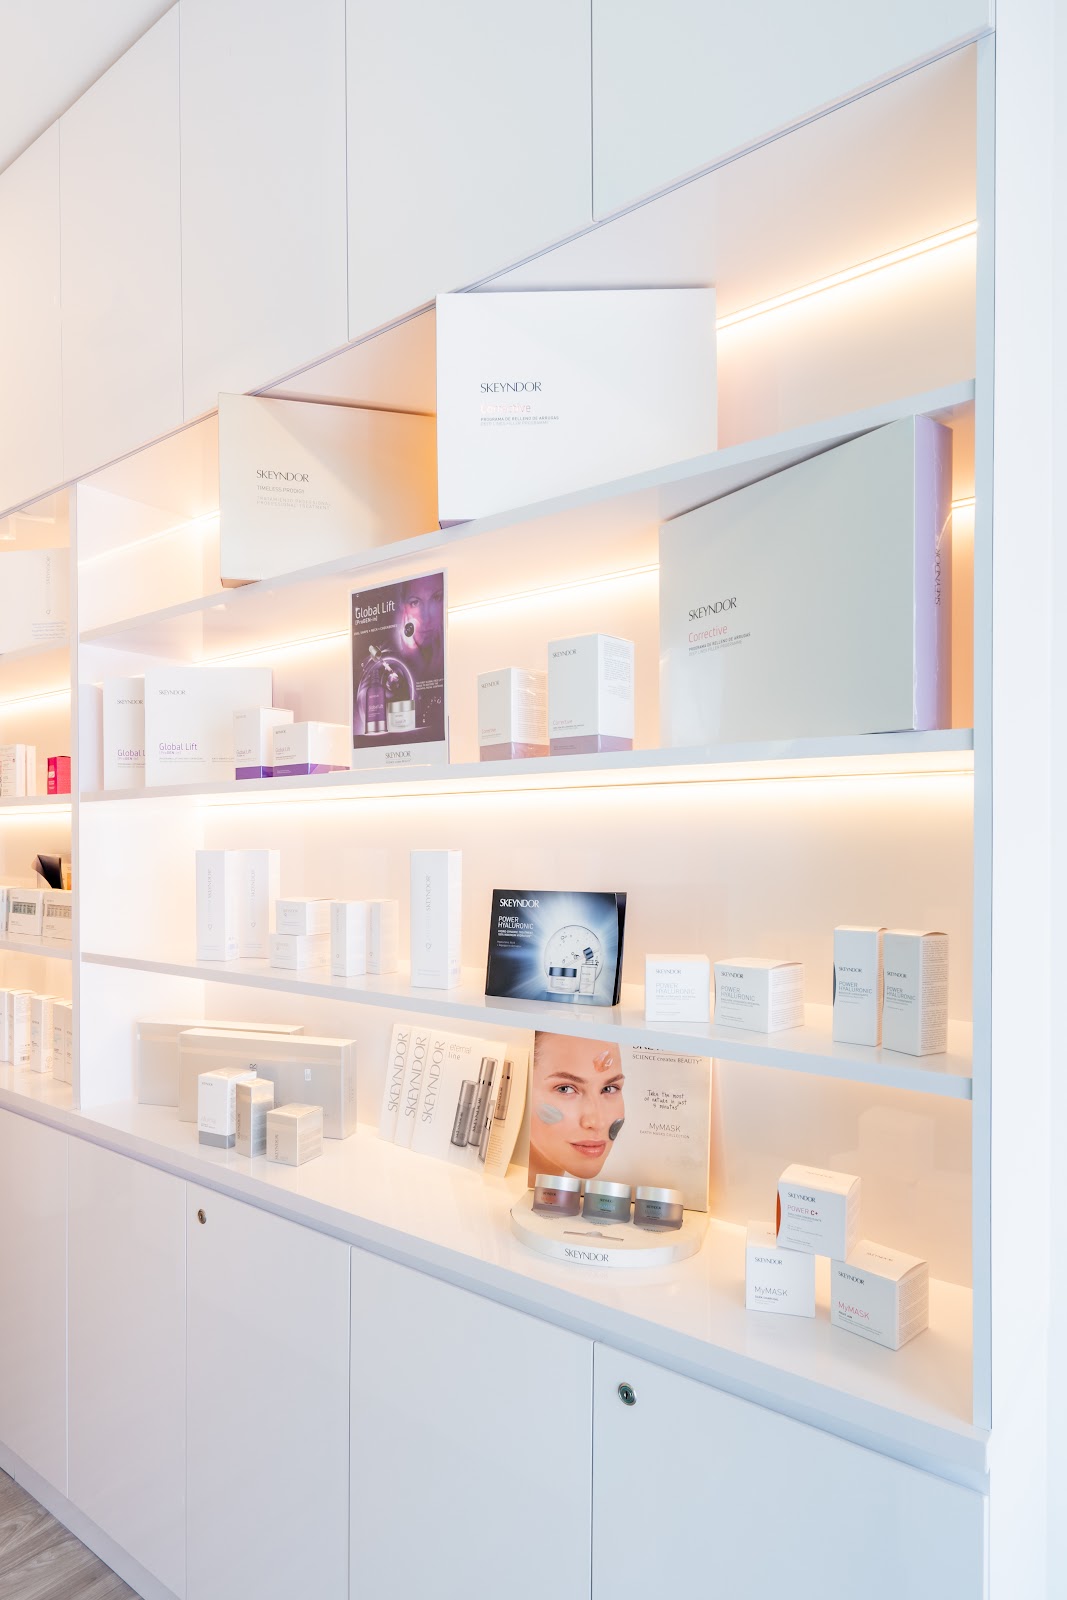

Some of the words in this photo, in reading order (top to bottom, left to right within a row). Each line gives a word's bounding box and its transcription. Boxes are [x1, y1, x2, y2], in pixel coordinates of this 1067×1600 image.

[480, 381, 543, 393] SKEYNDOR
[256, 469, 310, 482] SKEYNDOR
[355, 604, 380, 620] Global
[382, 600, 395, 614] Lift
[688, 597, 737, 622] SKEYNDOR
[688, 625, 728, 643] Corrective
[159, 743, 184, 751] Global
[185, 743, 198, 751] Lift
[117, 749, 142, 757] Global
[500, 898, 540, 908] SKEYNDOR
[498, 915, 519, 923] POWER
[498, 922, 534, 930] HYALURONIC
[721, 985, 741, 993] POWER
[839, 986, 873, 995] HYALURONIC
[721, 991, 756, 1002] HYALURONIC
[886, 992, 916, 1001] HYALURONIC
[450, 1045, 472, 1054] eternal
[448, 1053, 461, 1061] line
[388, 1033, 408, 1112] SKEYNDOR
[405, 1037, 427, 1118] SKEYNDOR
[422, 1041, 445, 1124] SKEYNDOR
[649, 1122, 681, 1133] MyMASK
[788, 1192, 816, 1203] SKEYNDOR
[788, 1204, 810, 1214] POWER
[564, 1247, 609, 1262] SKEYNDOR
[754, 1256, 783, 1265] SKEYNDOR
[838, 1271, 865, 1286] SKEYNDOR
[754, 1285, 788, 1297] MyMASK
[838, 1301, 870, 1320] MyMASK
